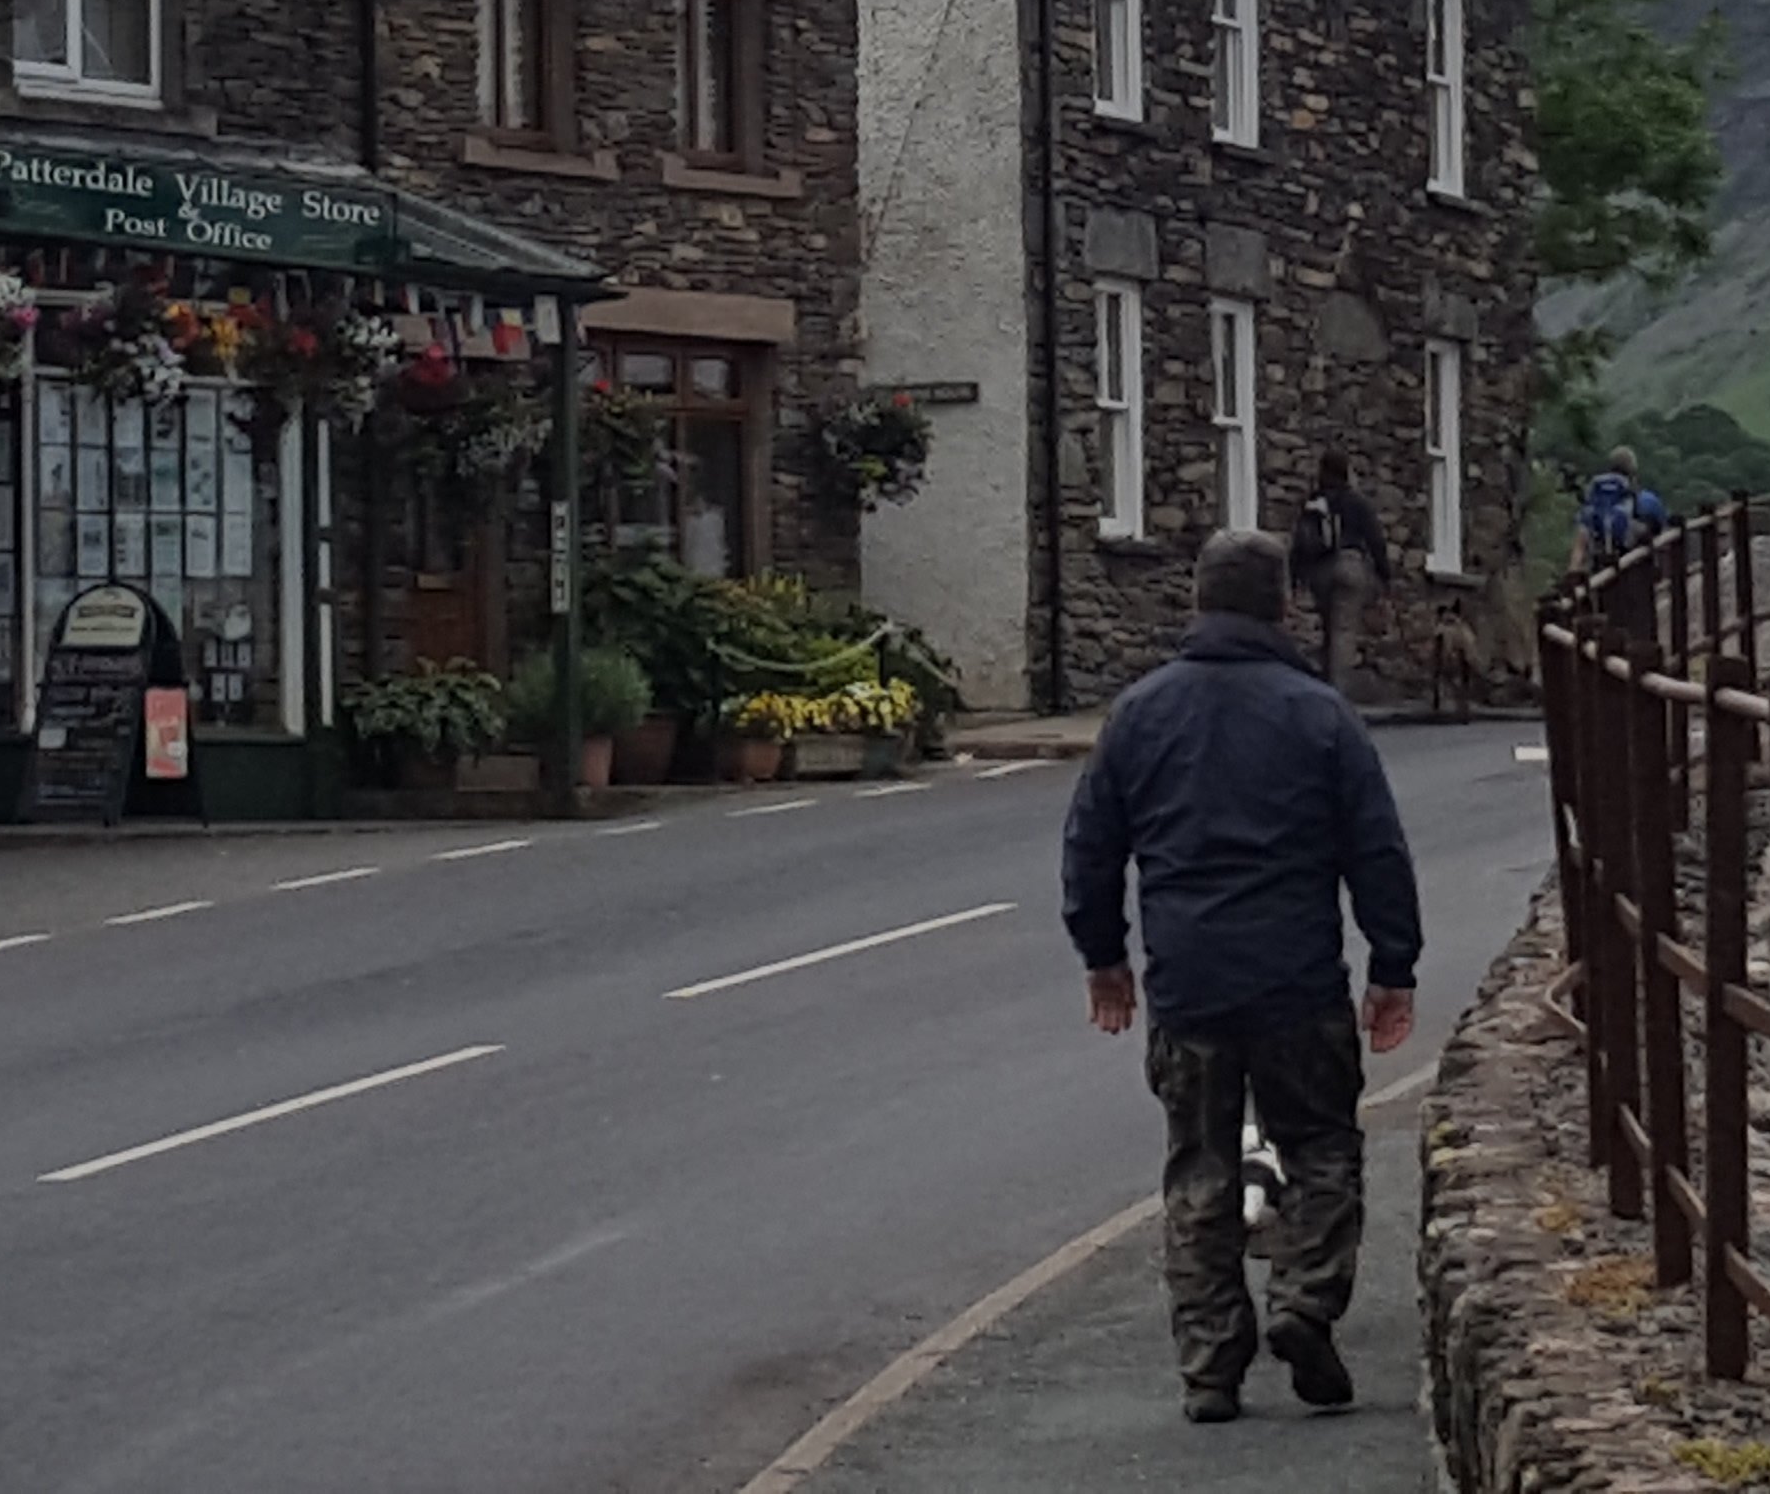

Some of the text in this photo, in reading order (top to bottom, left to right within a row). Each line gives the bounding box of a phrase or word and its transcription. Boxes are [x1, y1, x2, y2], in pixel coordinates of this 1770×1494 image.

[175, 174, 282, 220] Village
[302, 191, 381, 226] Store
[178, 203, 201, 220] &
[105, 208, 273, 251] Post Office
